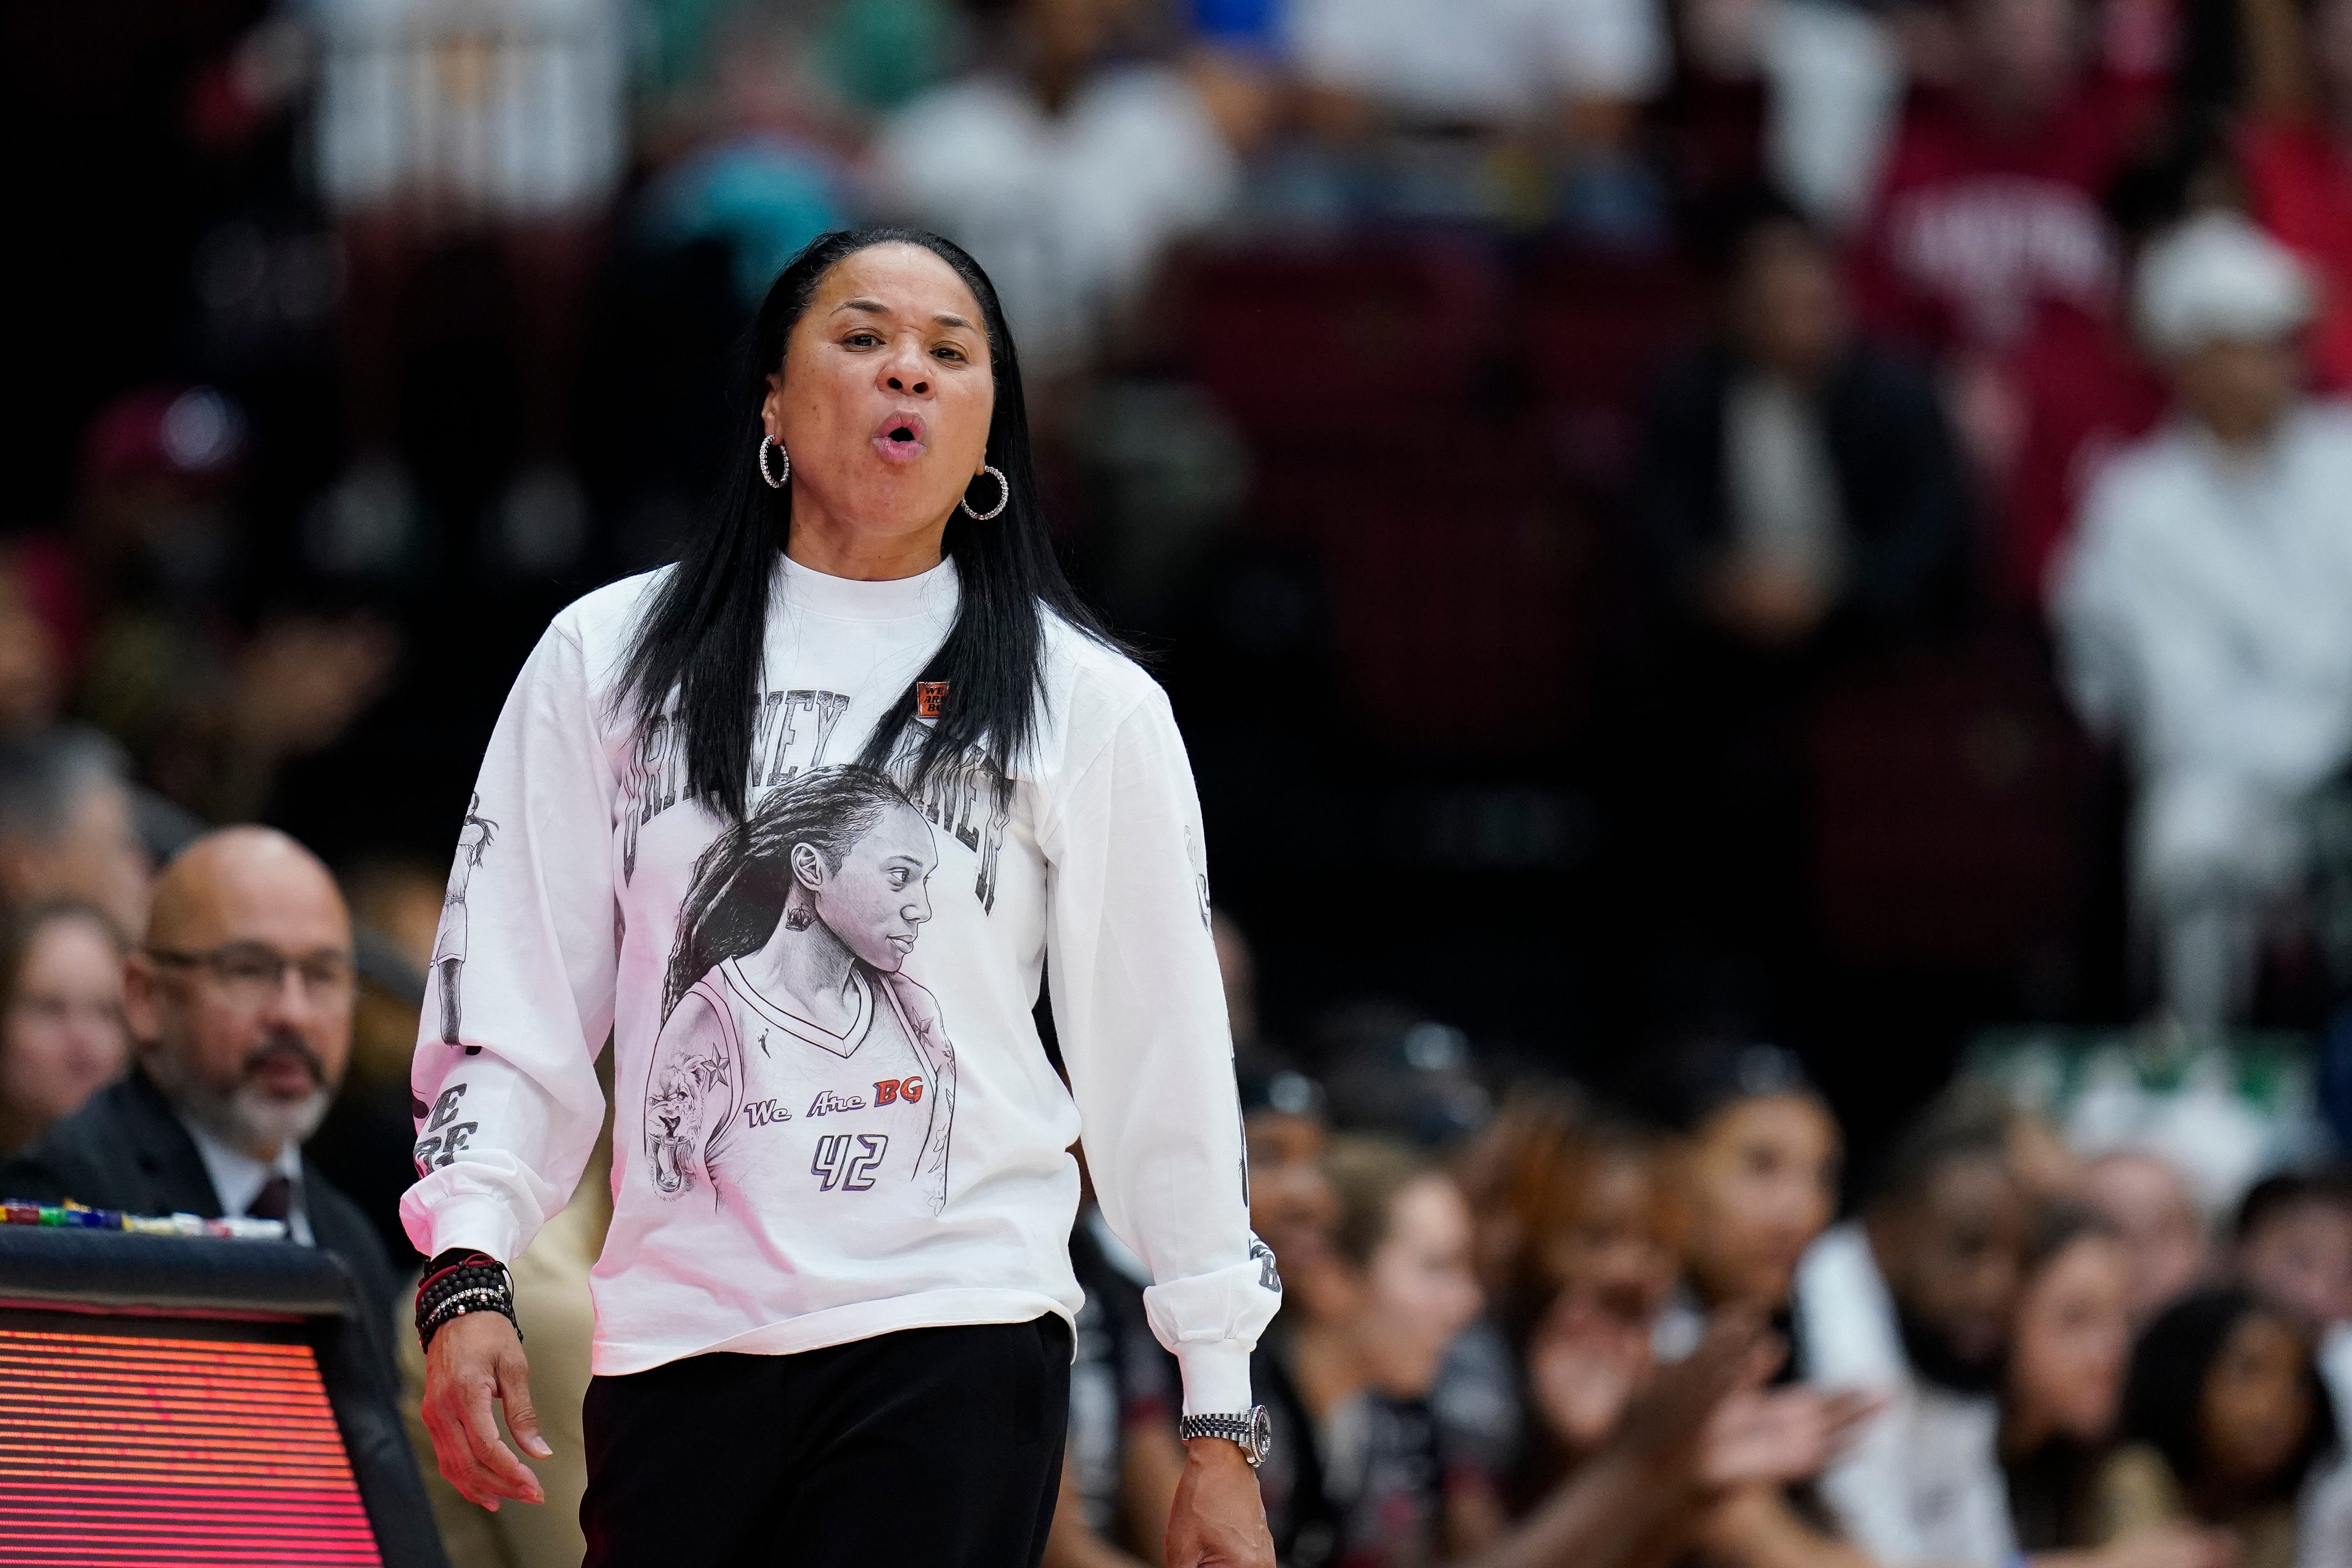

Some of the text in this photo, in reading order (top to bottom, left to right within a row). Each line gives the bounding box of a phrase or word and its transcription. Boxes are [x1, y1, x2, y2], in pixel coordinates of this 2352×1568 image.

[744, 1076, 923, 1127] We Are BG
[811, 1135, 889, 1191] 42
